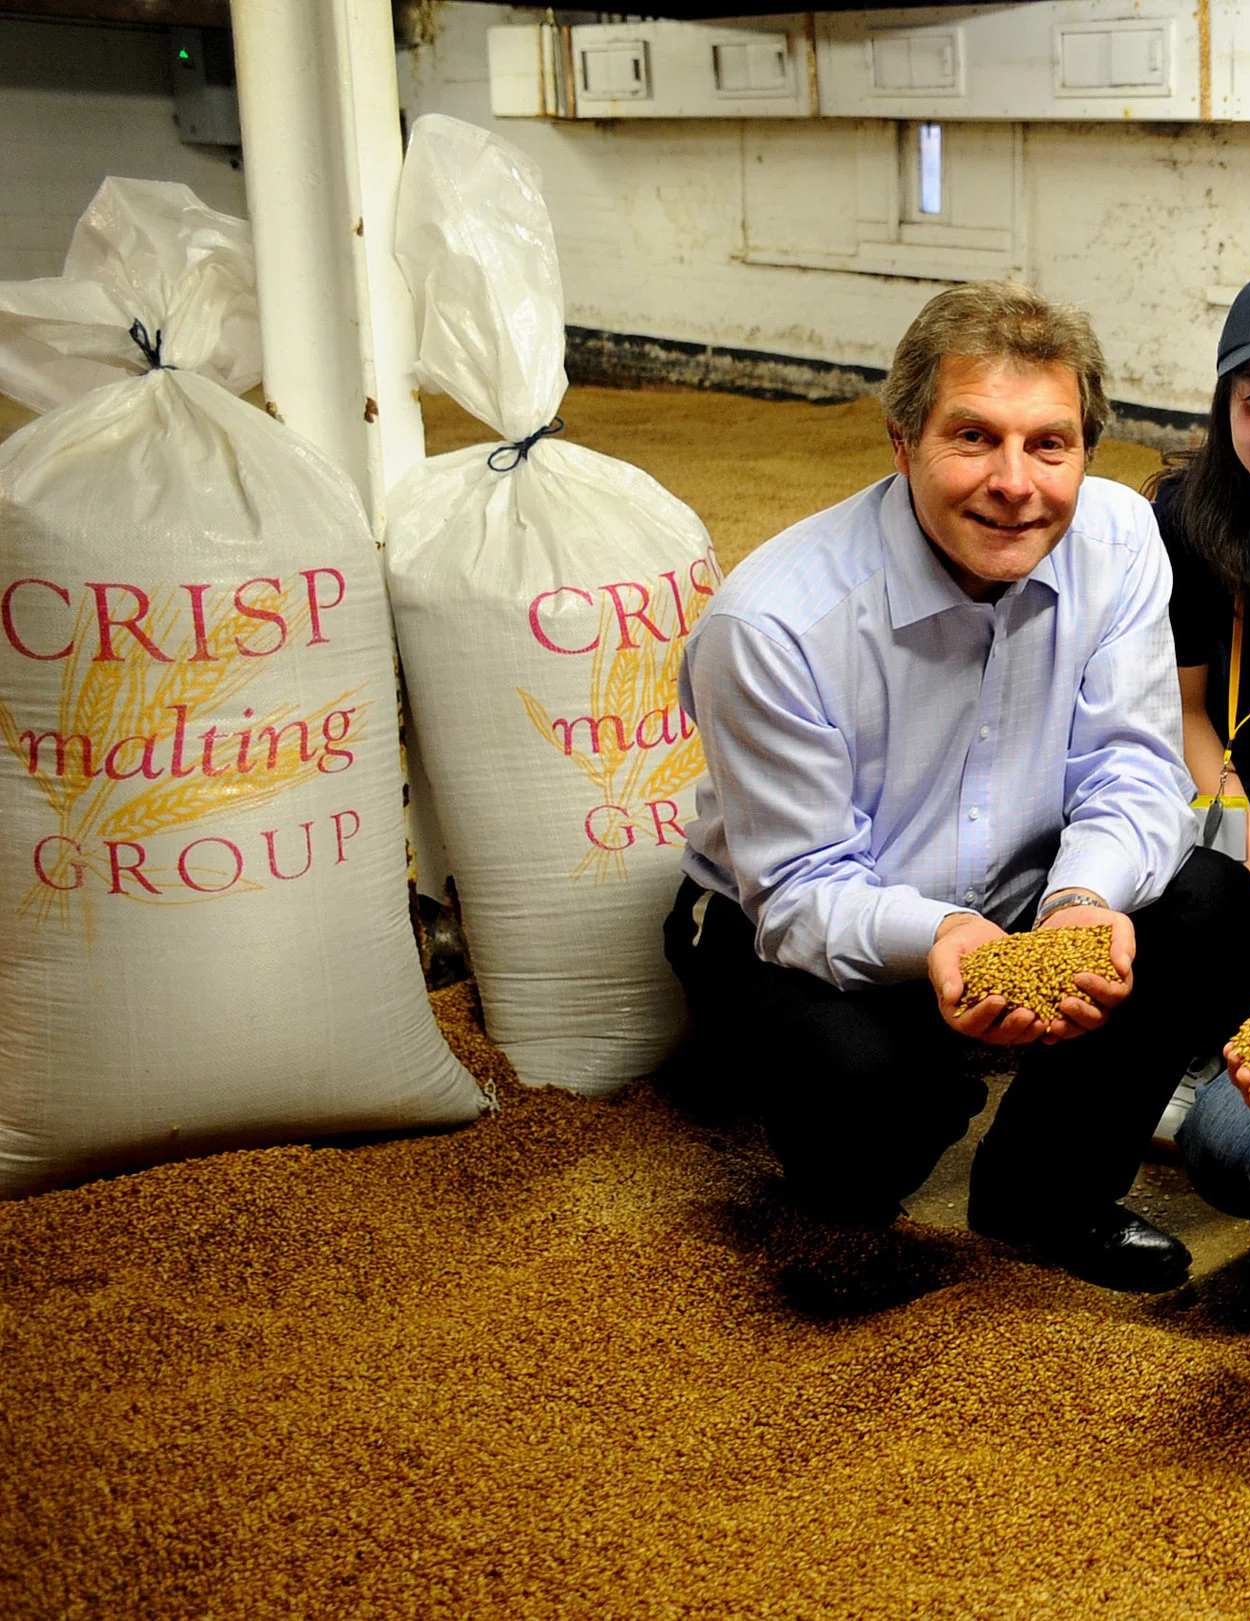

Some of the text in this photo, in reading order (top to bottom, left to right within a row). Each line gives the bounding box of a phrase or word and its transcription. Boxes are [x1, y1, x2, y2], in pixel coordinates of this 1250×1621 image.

[1, 567, 346, 662] CRISP
[19, 704, 356, 780] malting
[34, 810, 361, 895] GROUP
